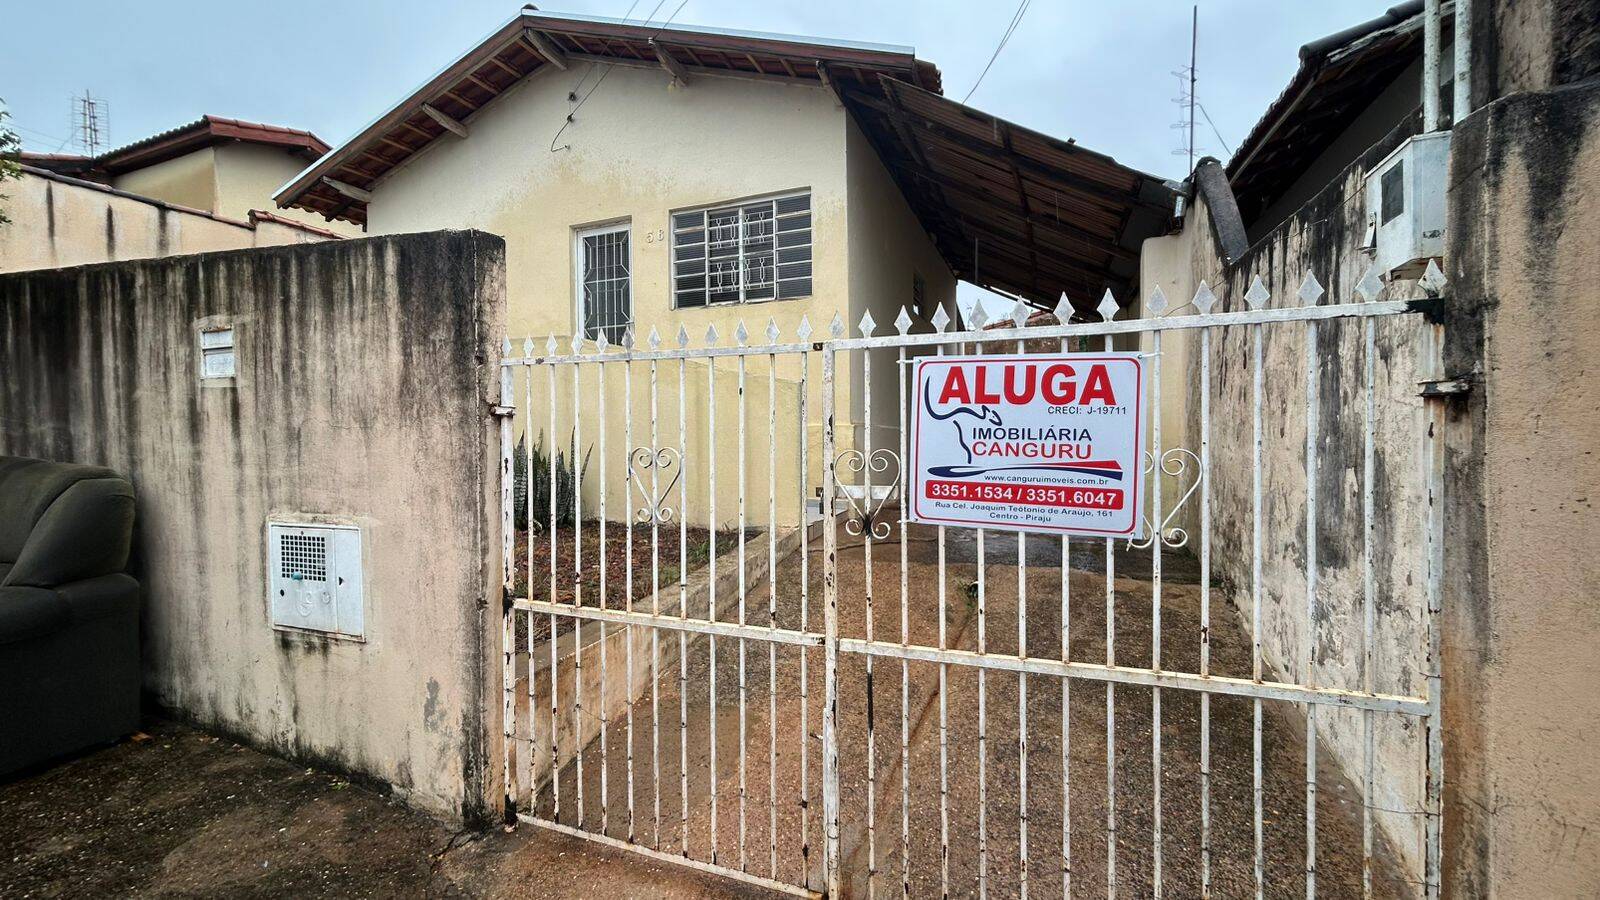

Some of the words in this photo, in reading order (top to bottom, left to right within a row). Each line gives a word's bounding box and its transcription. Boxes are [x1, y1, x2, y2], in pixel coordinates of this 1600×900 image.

[938, 364, 1116, 406] ALUGA
[1047, 406, 1082, 414] CRECI:
[972, 425, 1092, 441] IMOBILIÁRIA
[972, 442, 1092, 459] CANGURU
[984, 475, 1108, 485] www.canguruimoveis.com.br
[932, 484, 1013, 499] 3351.1534
[1017, 487, 1023, 499] /
[1026, 489, 1117, 505] 3351.6047
[970, 503, 1006, 512] Joaquim
[1061, 508, 1094, 517] Araújo,
[990, 512, 1019, 520] Centro
[1026, 514, 1051, 522] Piraju
